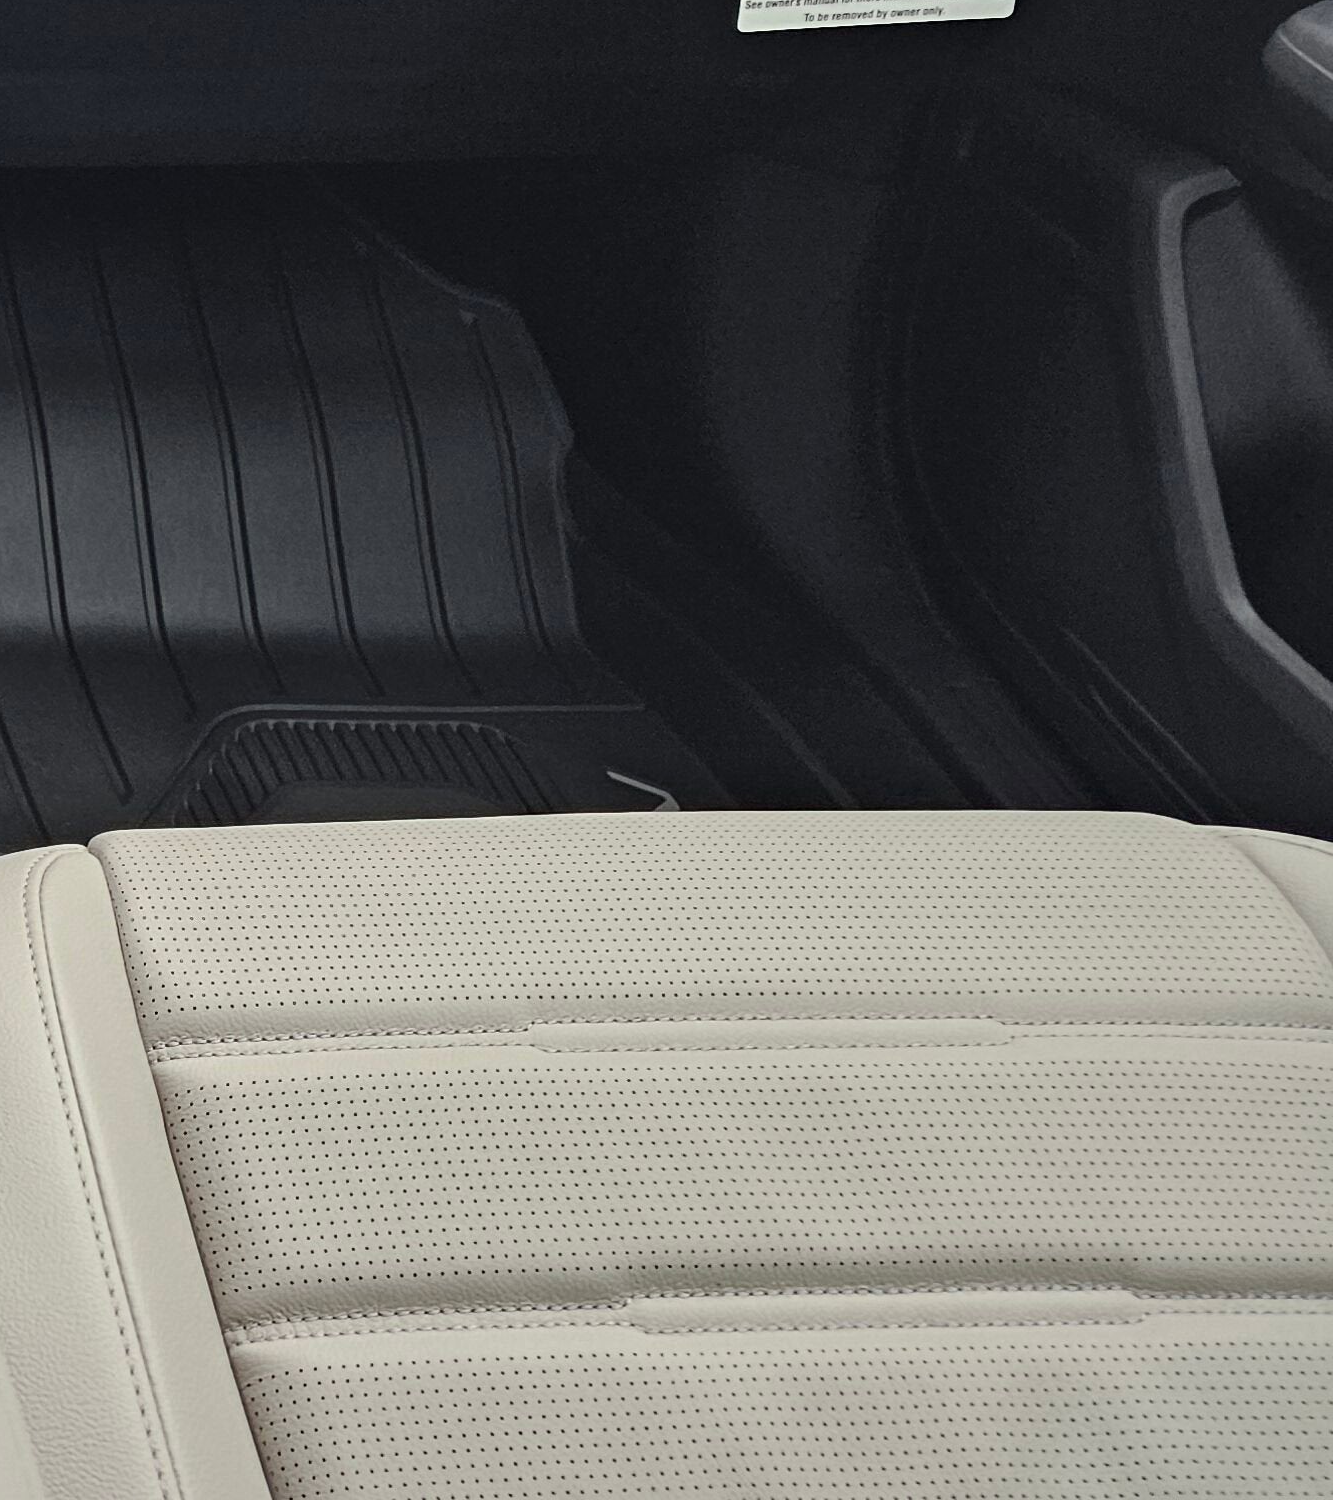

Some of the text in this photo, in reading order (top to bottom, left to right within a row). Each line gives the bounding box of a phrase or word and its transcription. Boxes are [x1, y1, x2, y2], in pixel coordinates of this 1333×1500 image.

[745, 0, 763, 10] See
[804, 13, 815, 22] To
[817, 12, 829, 21] be
[831, 10, 873, 21] removed
[876, 8, 887, 19] by
[890, 8, 921, 17] owner
